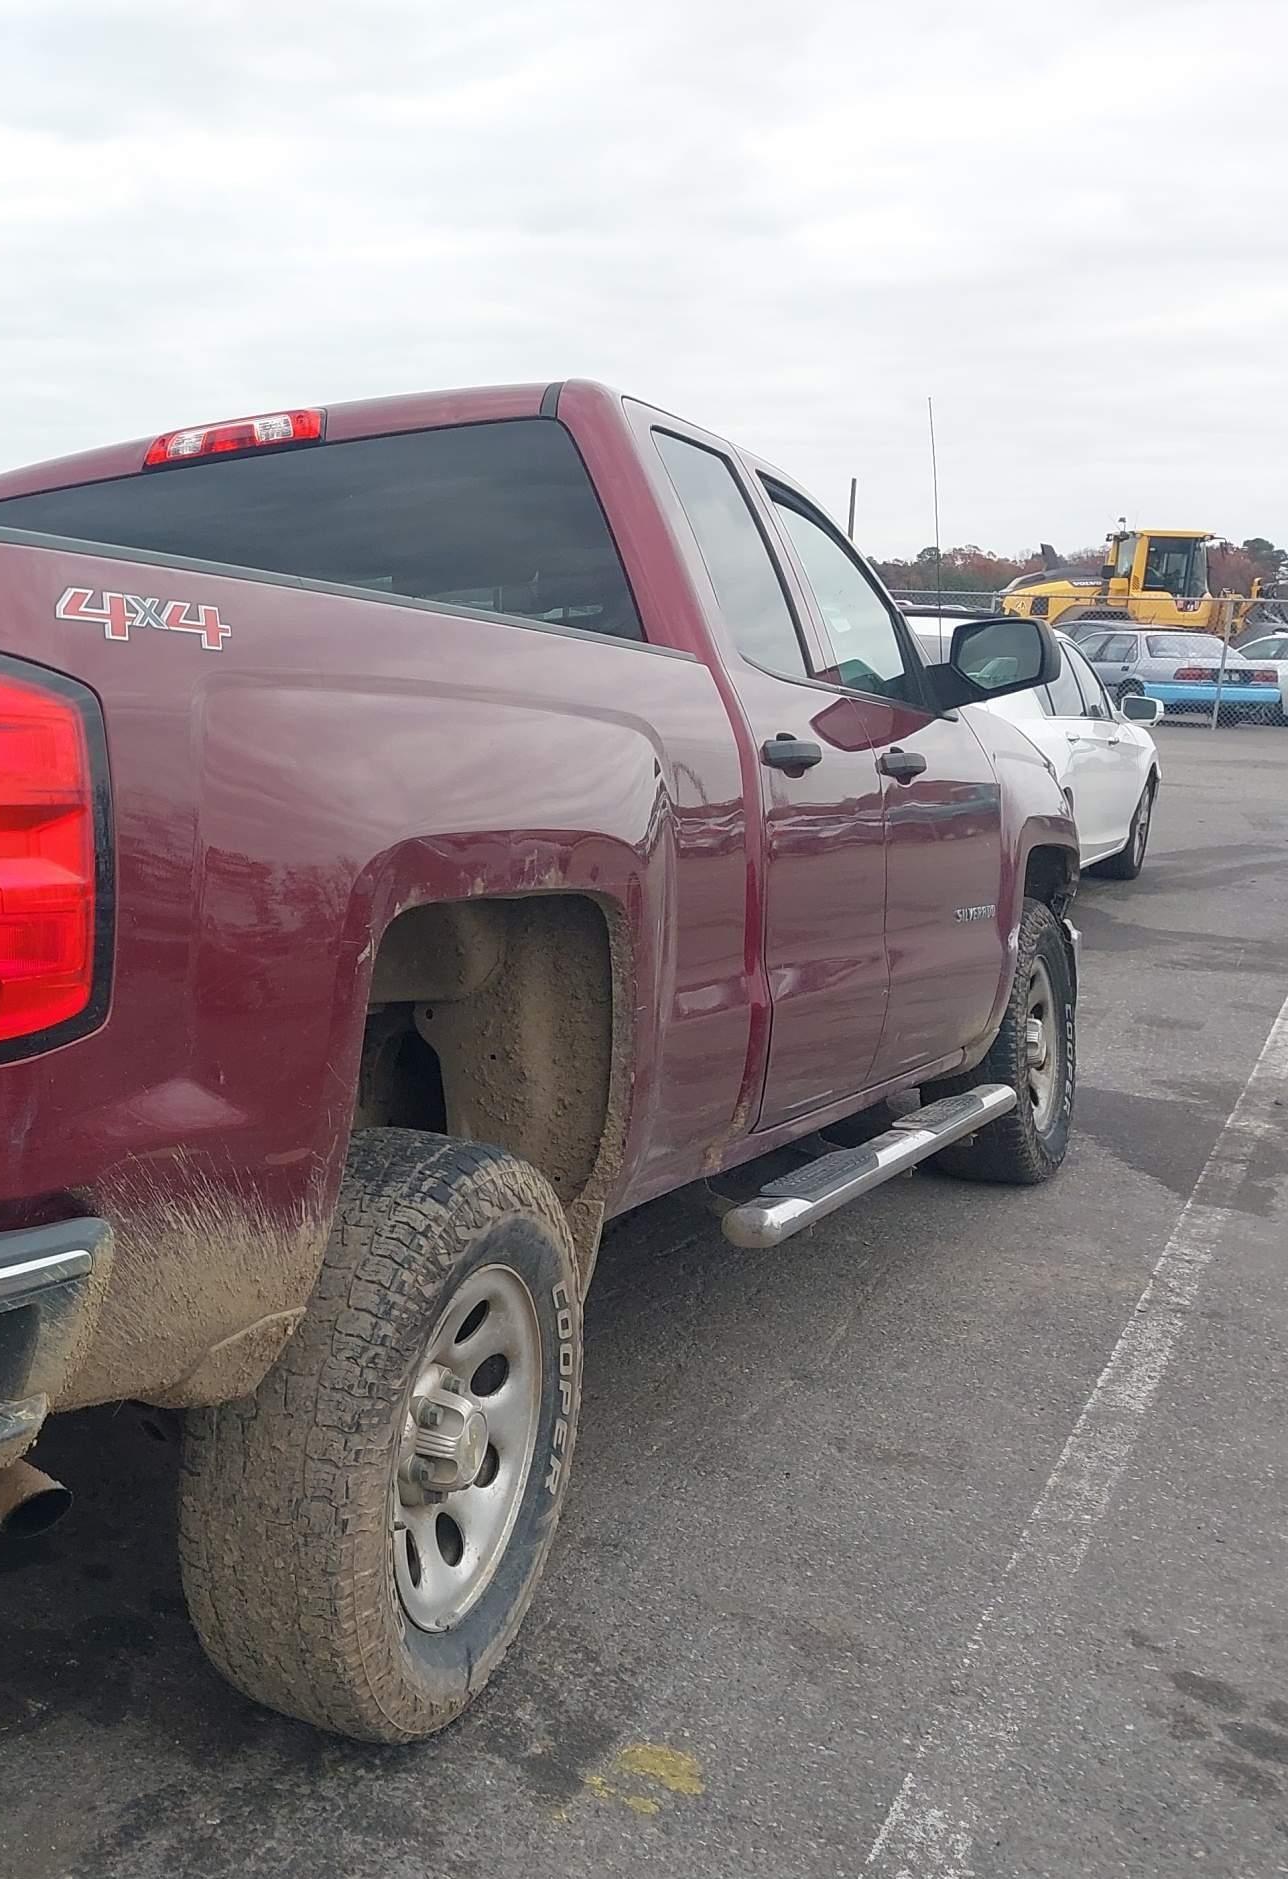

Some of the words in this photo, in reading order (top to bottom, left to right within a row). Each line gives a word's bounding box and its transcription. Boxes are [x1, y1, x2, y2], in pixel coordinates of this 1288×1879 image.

[954, 904, 996, 922] SILVERADO
[1064, 1003, 1073, 1117] COOPER
[545, 1280, 573, 1495] COOPER
